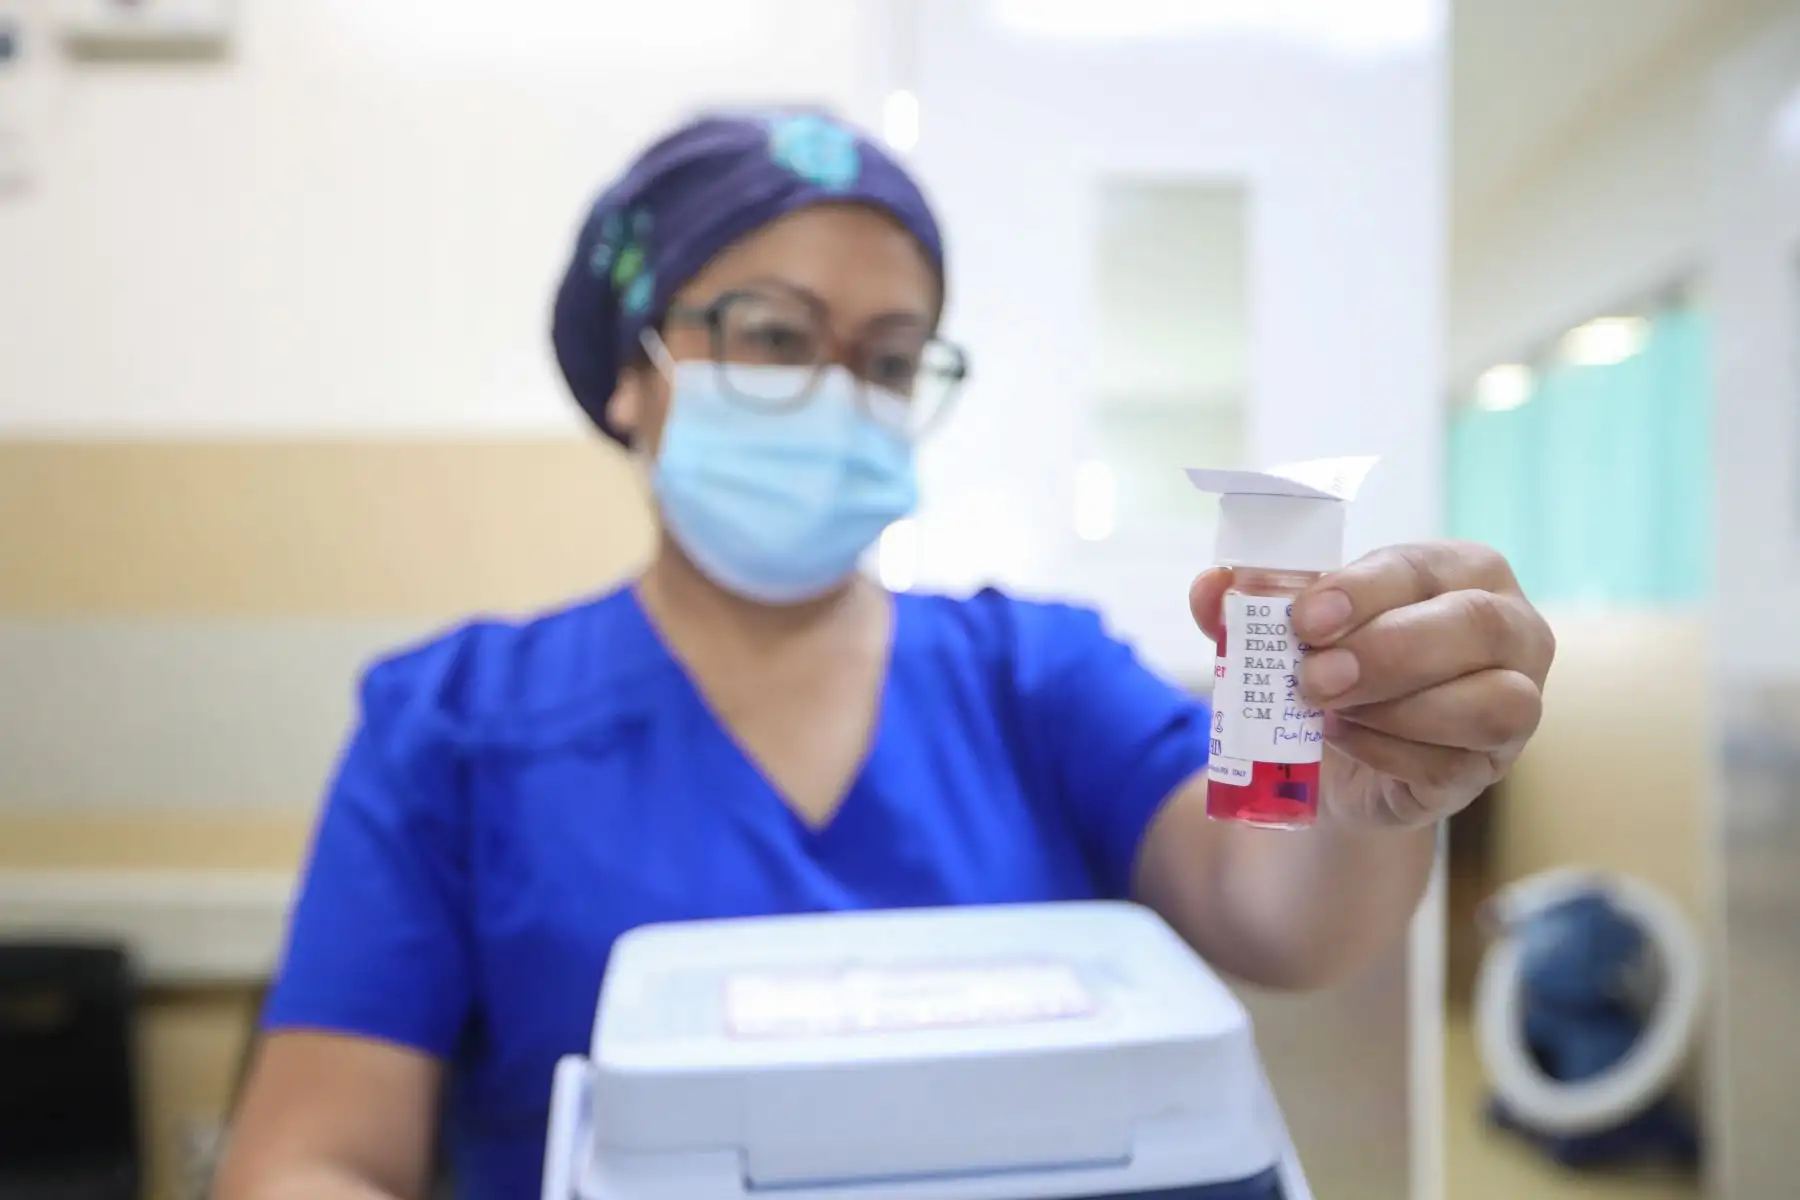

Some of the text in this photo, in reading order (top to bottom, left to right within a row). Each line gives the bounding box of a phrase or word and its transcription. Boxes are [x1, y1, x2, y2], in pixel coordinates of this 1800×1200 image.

[1246, 623, 1287, 635] SEXO
[1245, 640, 1288, 651] EDAD
[1244, 657, 1286, 669] RAZA
